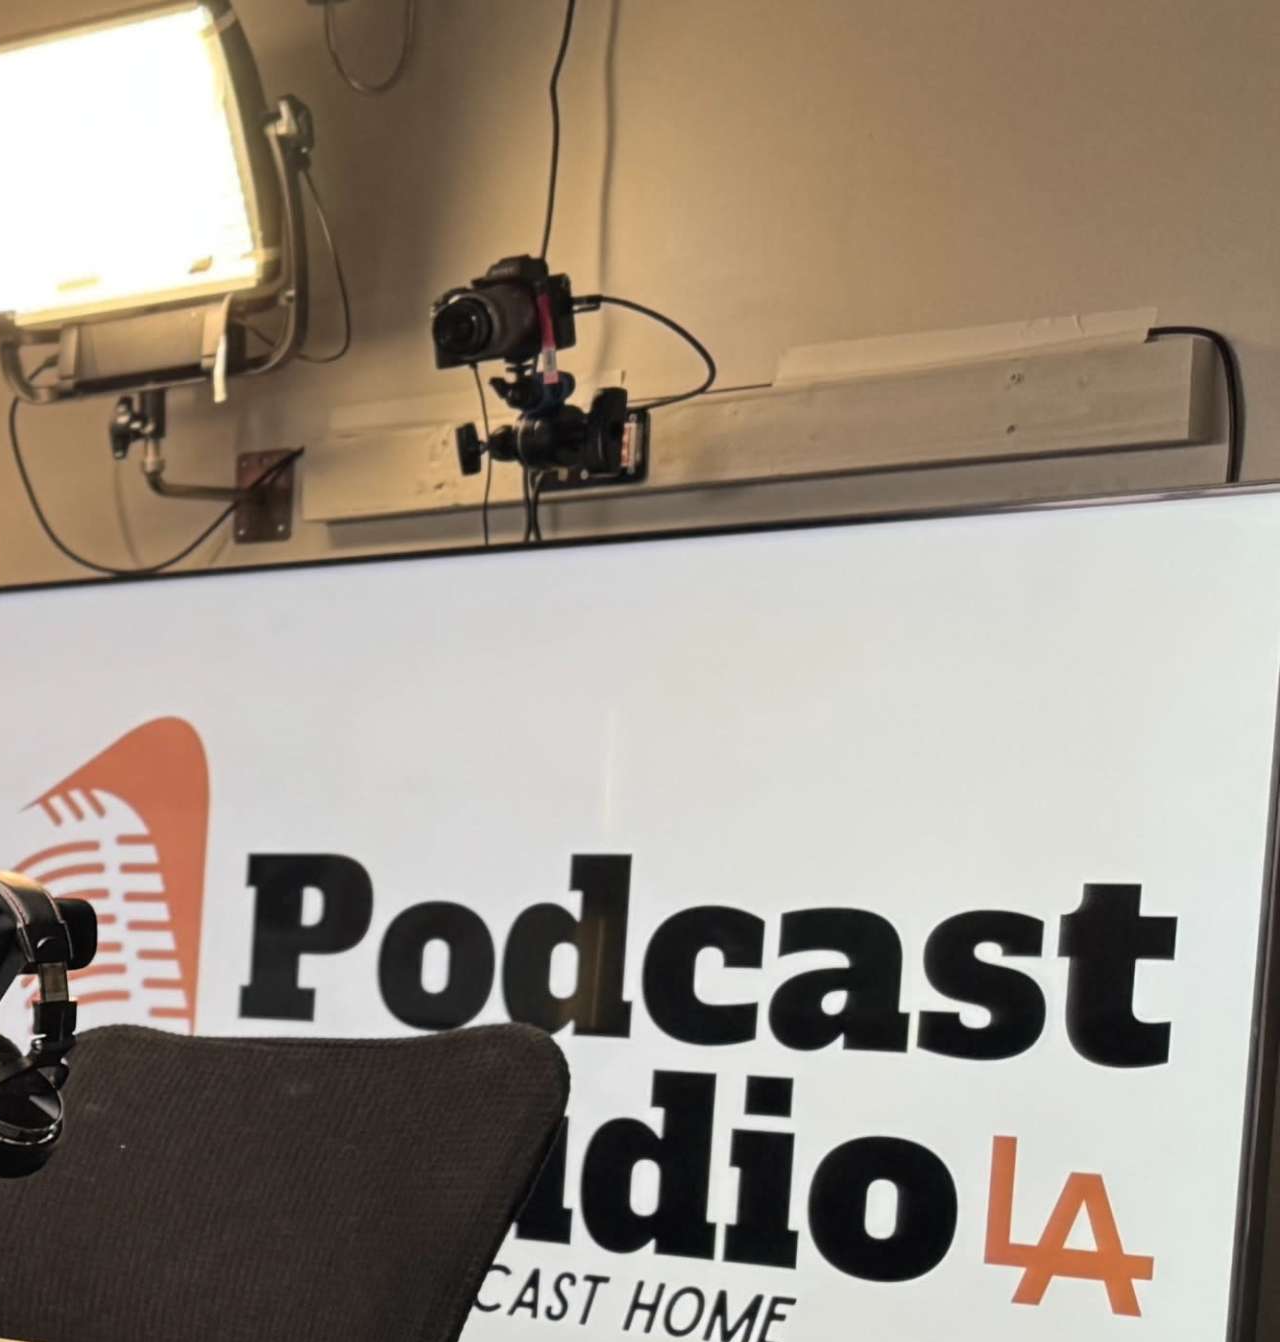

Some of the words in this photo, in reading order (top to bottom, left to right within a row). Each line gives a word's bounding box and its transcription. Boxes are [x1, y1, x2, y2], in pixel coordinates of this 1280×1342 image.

[238, 852, 1178, 1069] Podcast
[474, 1264, 611, 1325] CAST
[515, 1069, 958, 1283] dio
[984, 1135, 1154, 1317] LA
